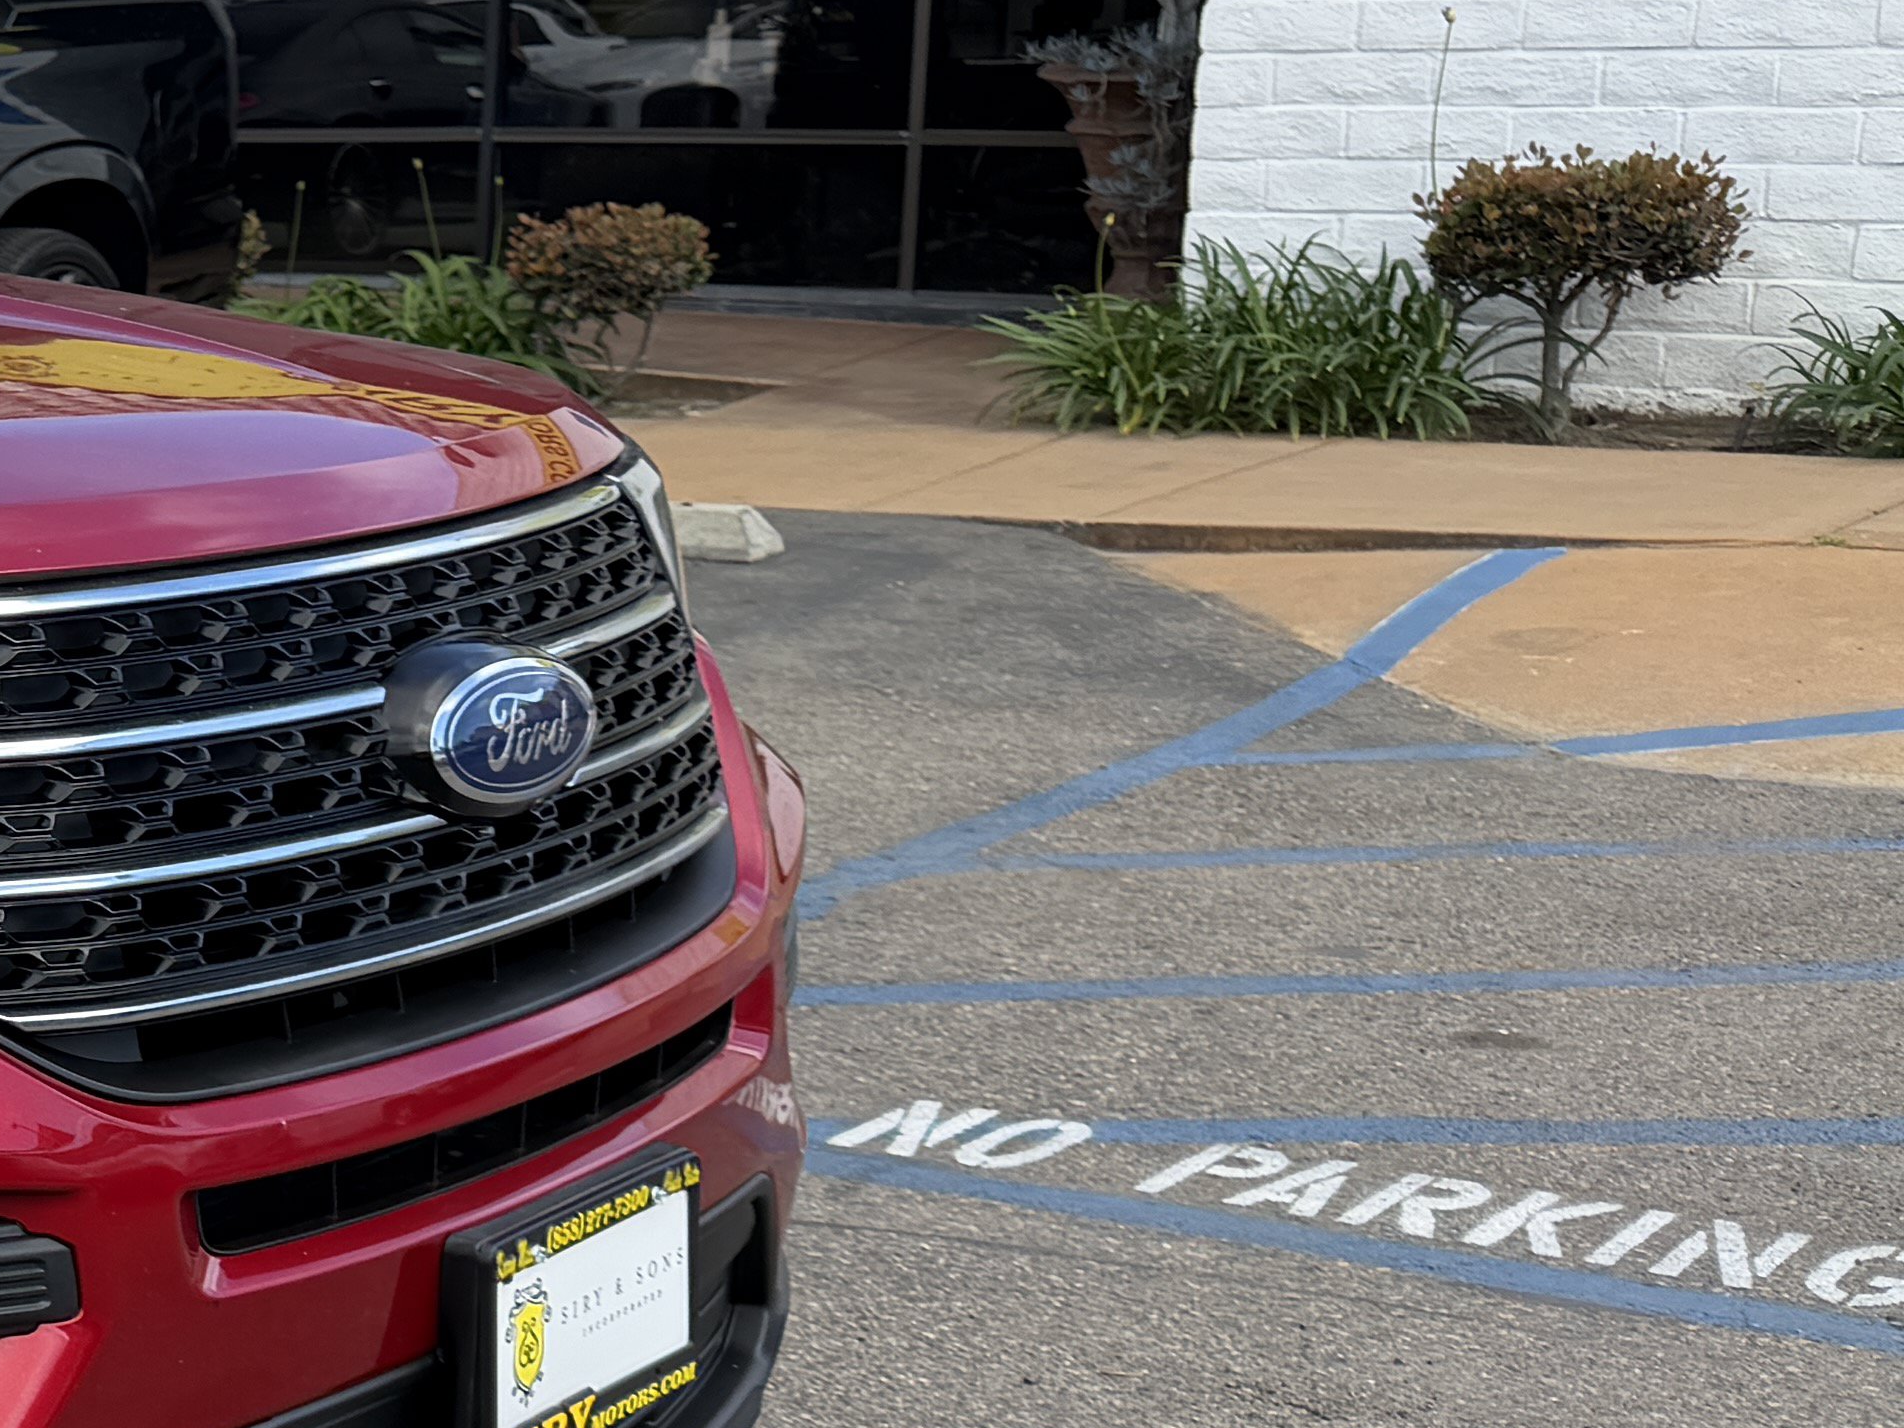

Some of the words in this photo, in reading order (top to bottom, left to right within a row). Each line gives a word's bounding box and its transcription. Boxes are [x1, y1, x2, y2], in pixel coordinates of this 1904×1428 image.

[487, 688, 572, 772] Ford
[586, 1185, 651, 1234] 277-7300
[826, 1100, 1094, 1169] NO
[1134, 1142, 1904, 1308] PARKING
